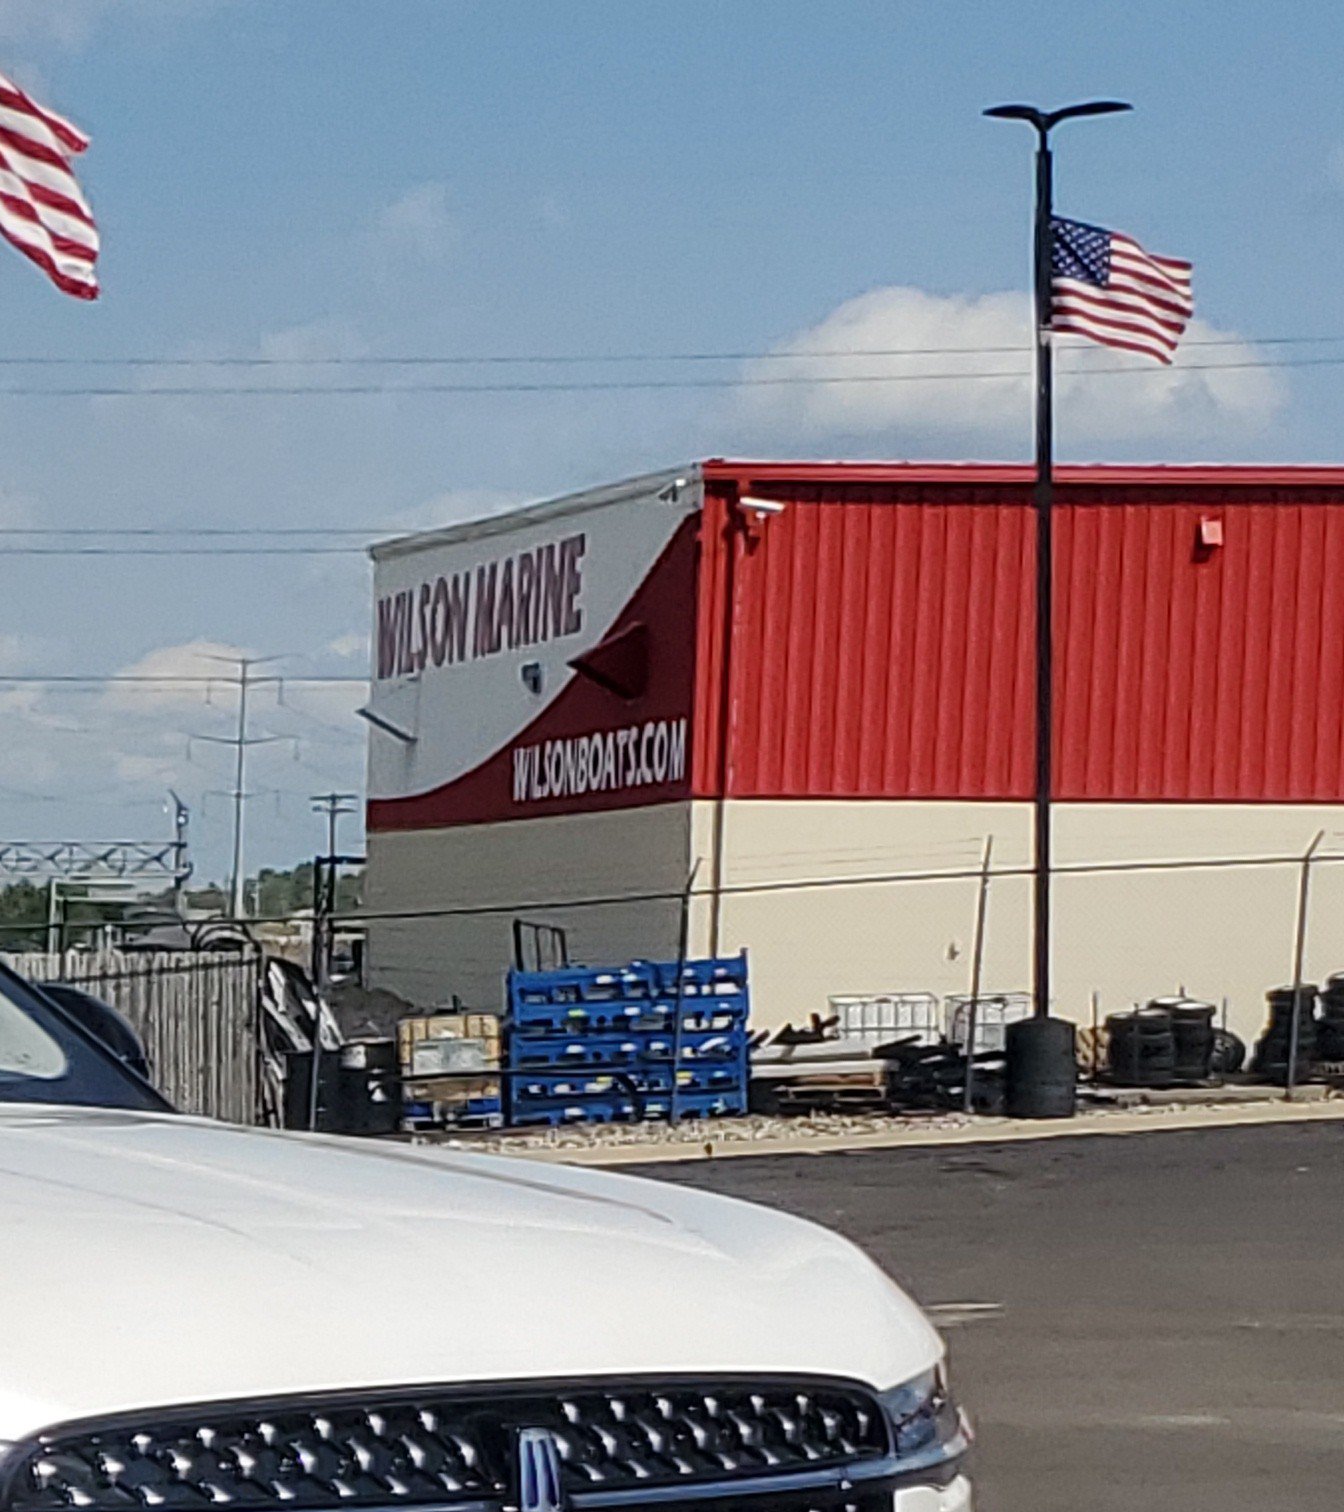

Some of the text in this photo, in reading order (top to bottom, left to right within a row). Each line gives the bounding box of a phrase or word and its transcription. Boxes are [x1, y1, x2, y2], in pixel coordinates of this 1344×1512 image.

[377, 532, 586, 681] WILSON MARINE
[513, 717, 687, 801] WILSONBOATS.COM
